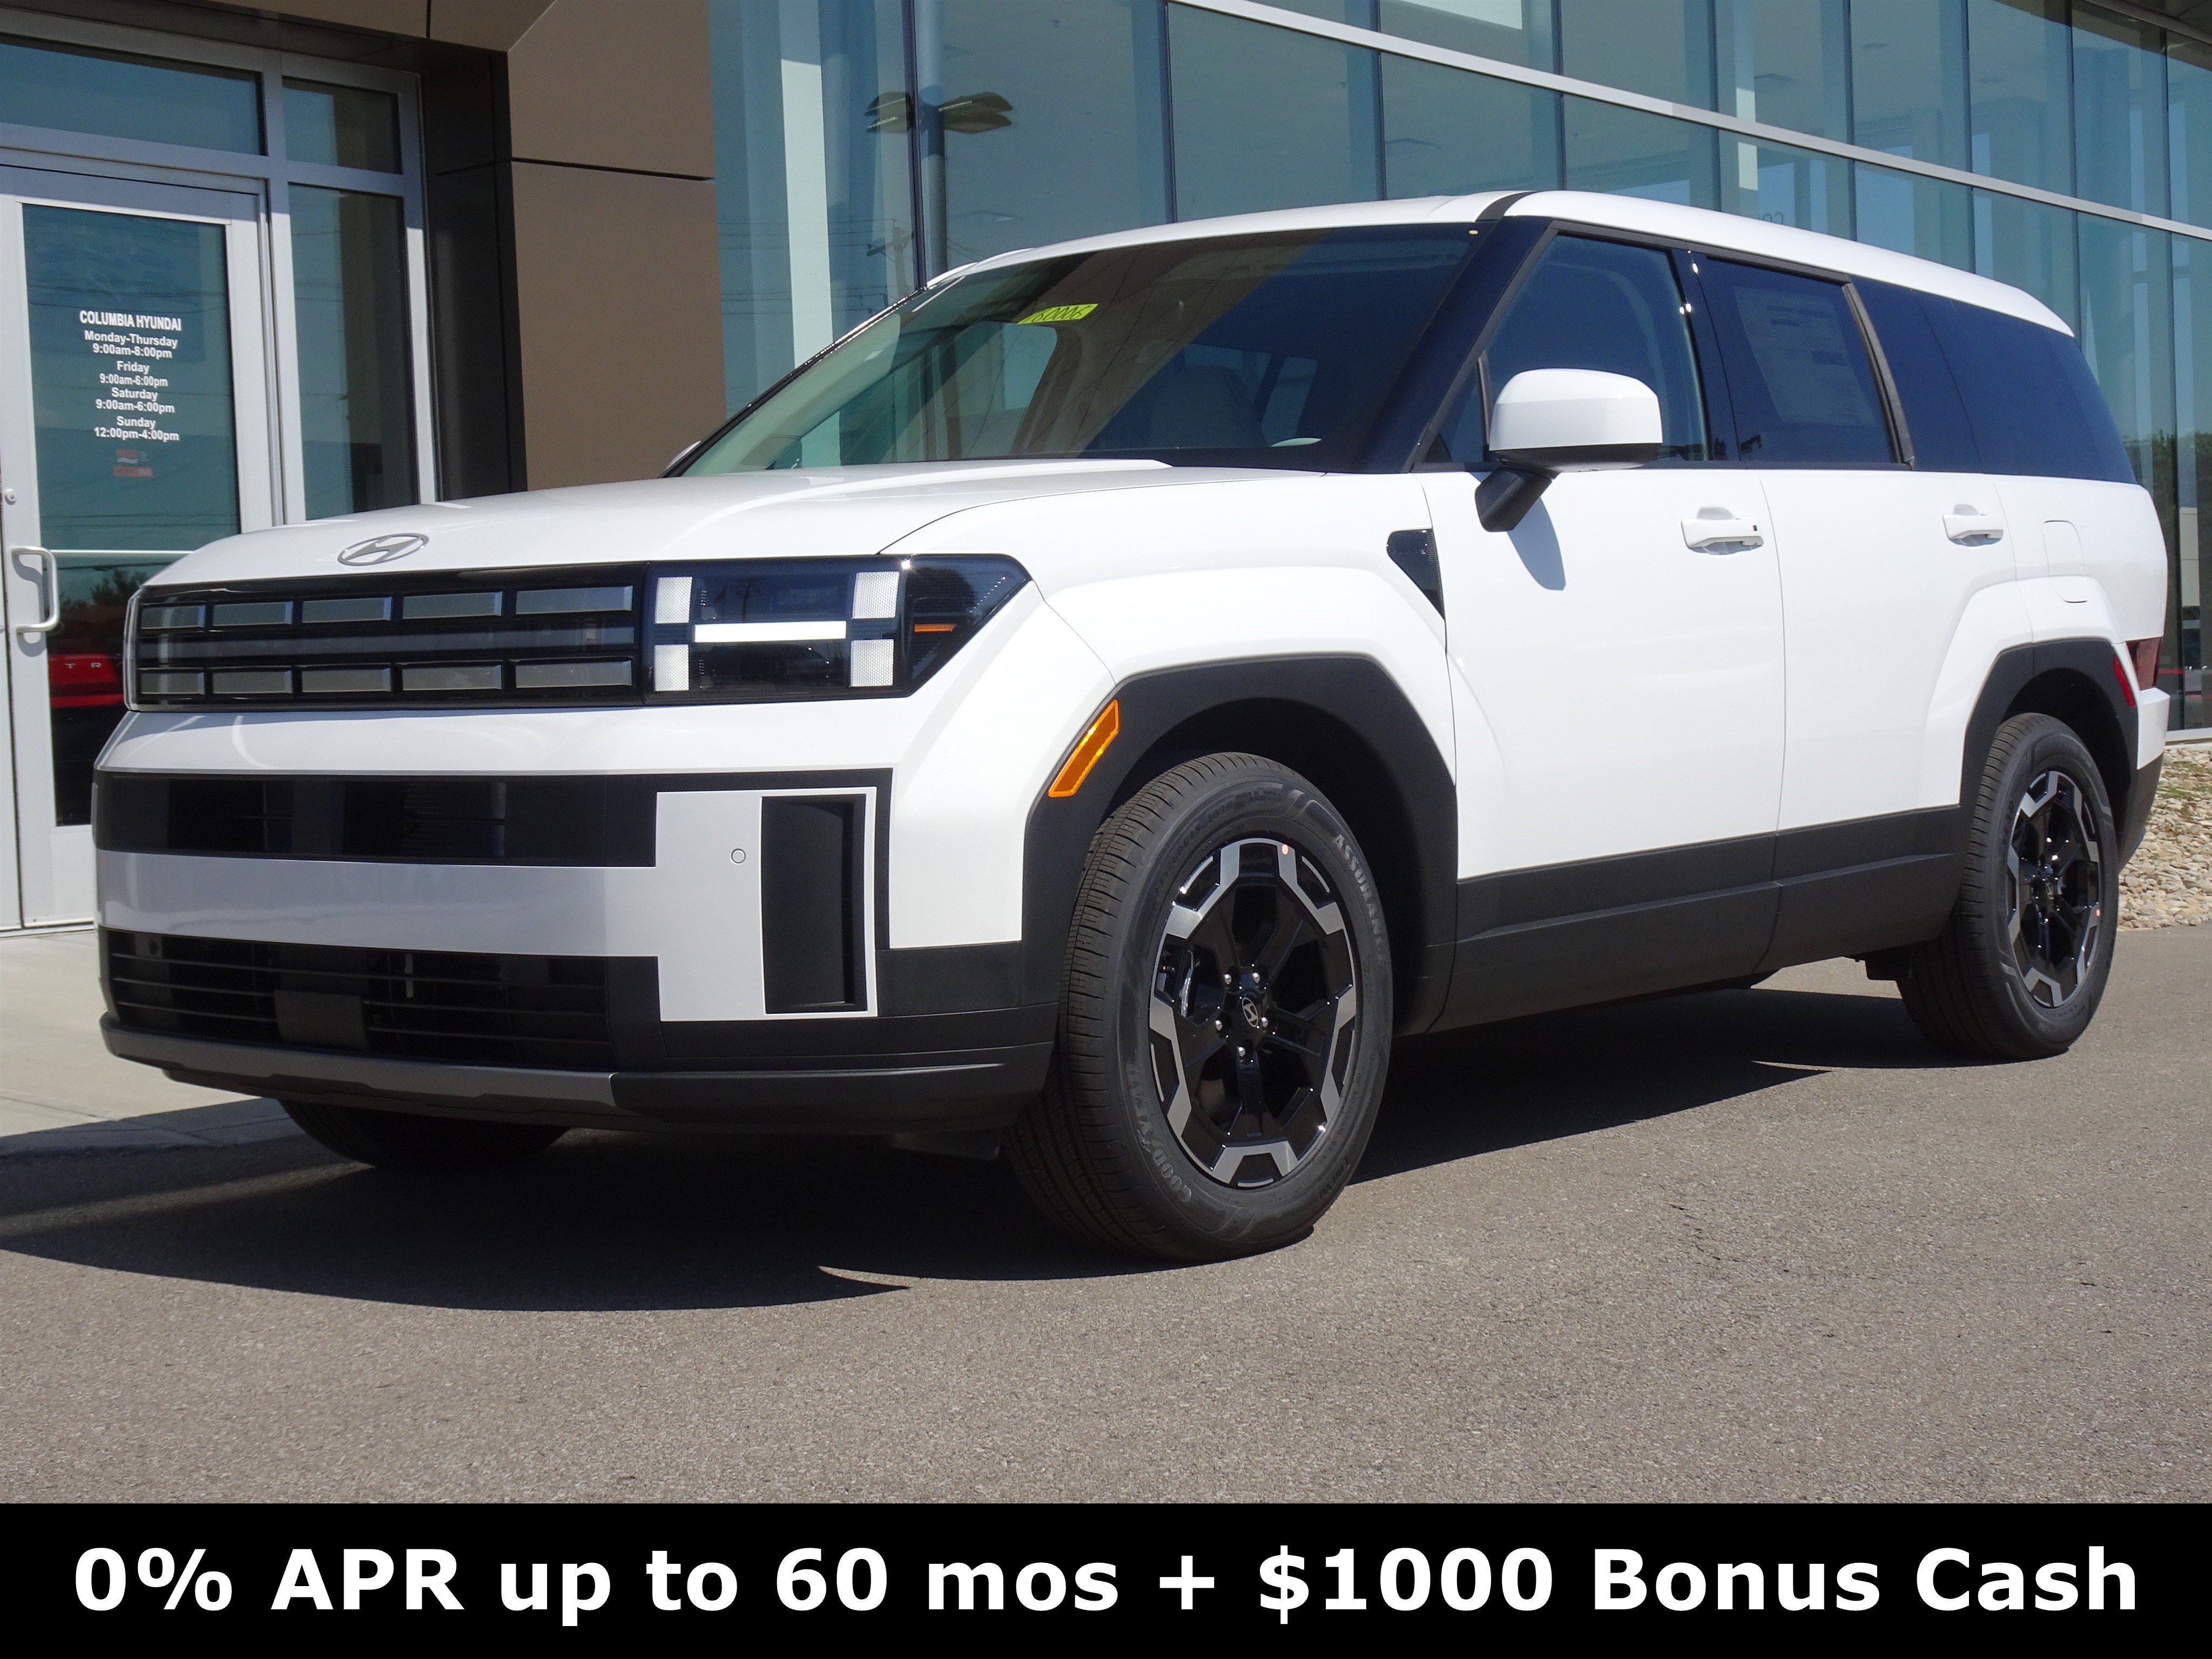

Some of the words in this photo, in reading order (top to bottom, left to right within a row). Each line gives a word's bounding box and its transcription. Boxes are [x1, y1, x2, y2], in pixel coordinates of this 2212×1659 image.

[79, 309, 134, 327] COLUMBIA
[136, 315, 181, 331] HYUNDAI
[84, 330, 178, 349] Monday-Thursday
[92, 343, 172, 359] 9:00am-8:00pm
[117, 360, 150, 374] Friday
[99, 373, 168, 388] 9:00am-6:00pm
[111, 387, 158, 402] Saturday
[96, 399, 174, 414] 9:00am-6:00pm
[117, 415, 156, 429] Sunday
[94, 427, 179, 442] 12:00pm-4:00pm
[1333, 834, 1386, 964] ASSURANCE
[1126, 1062, 1192, 1202] GOODYEAR
